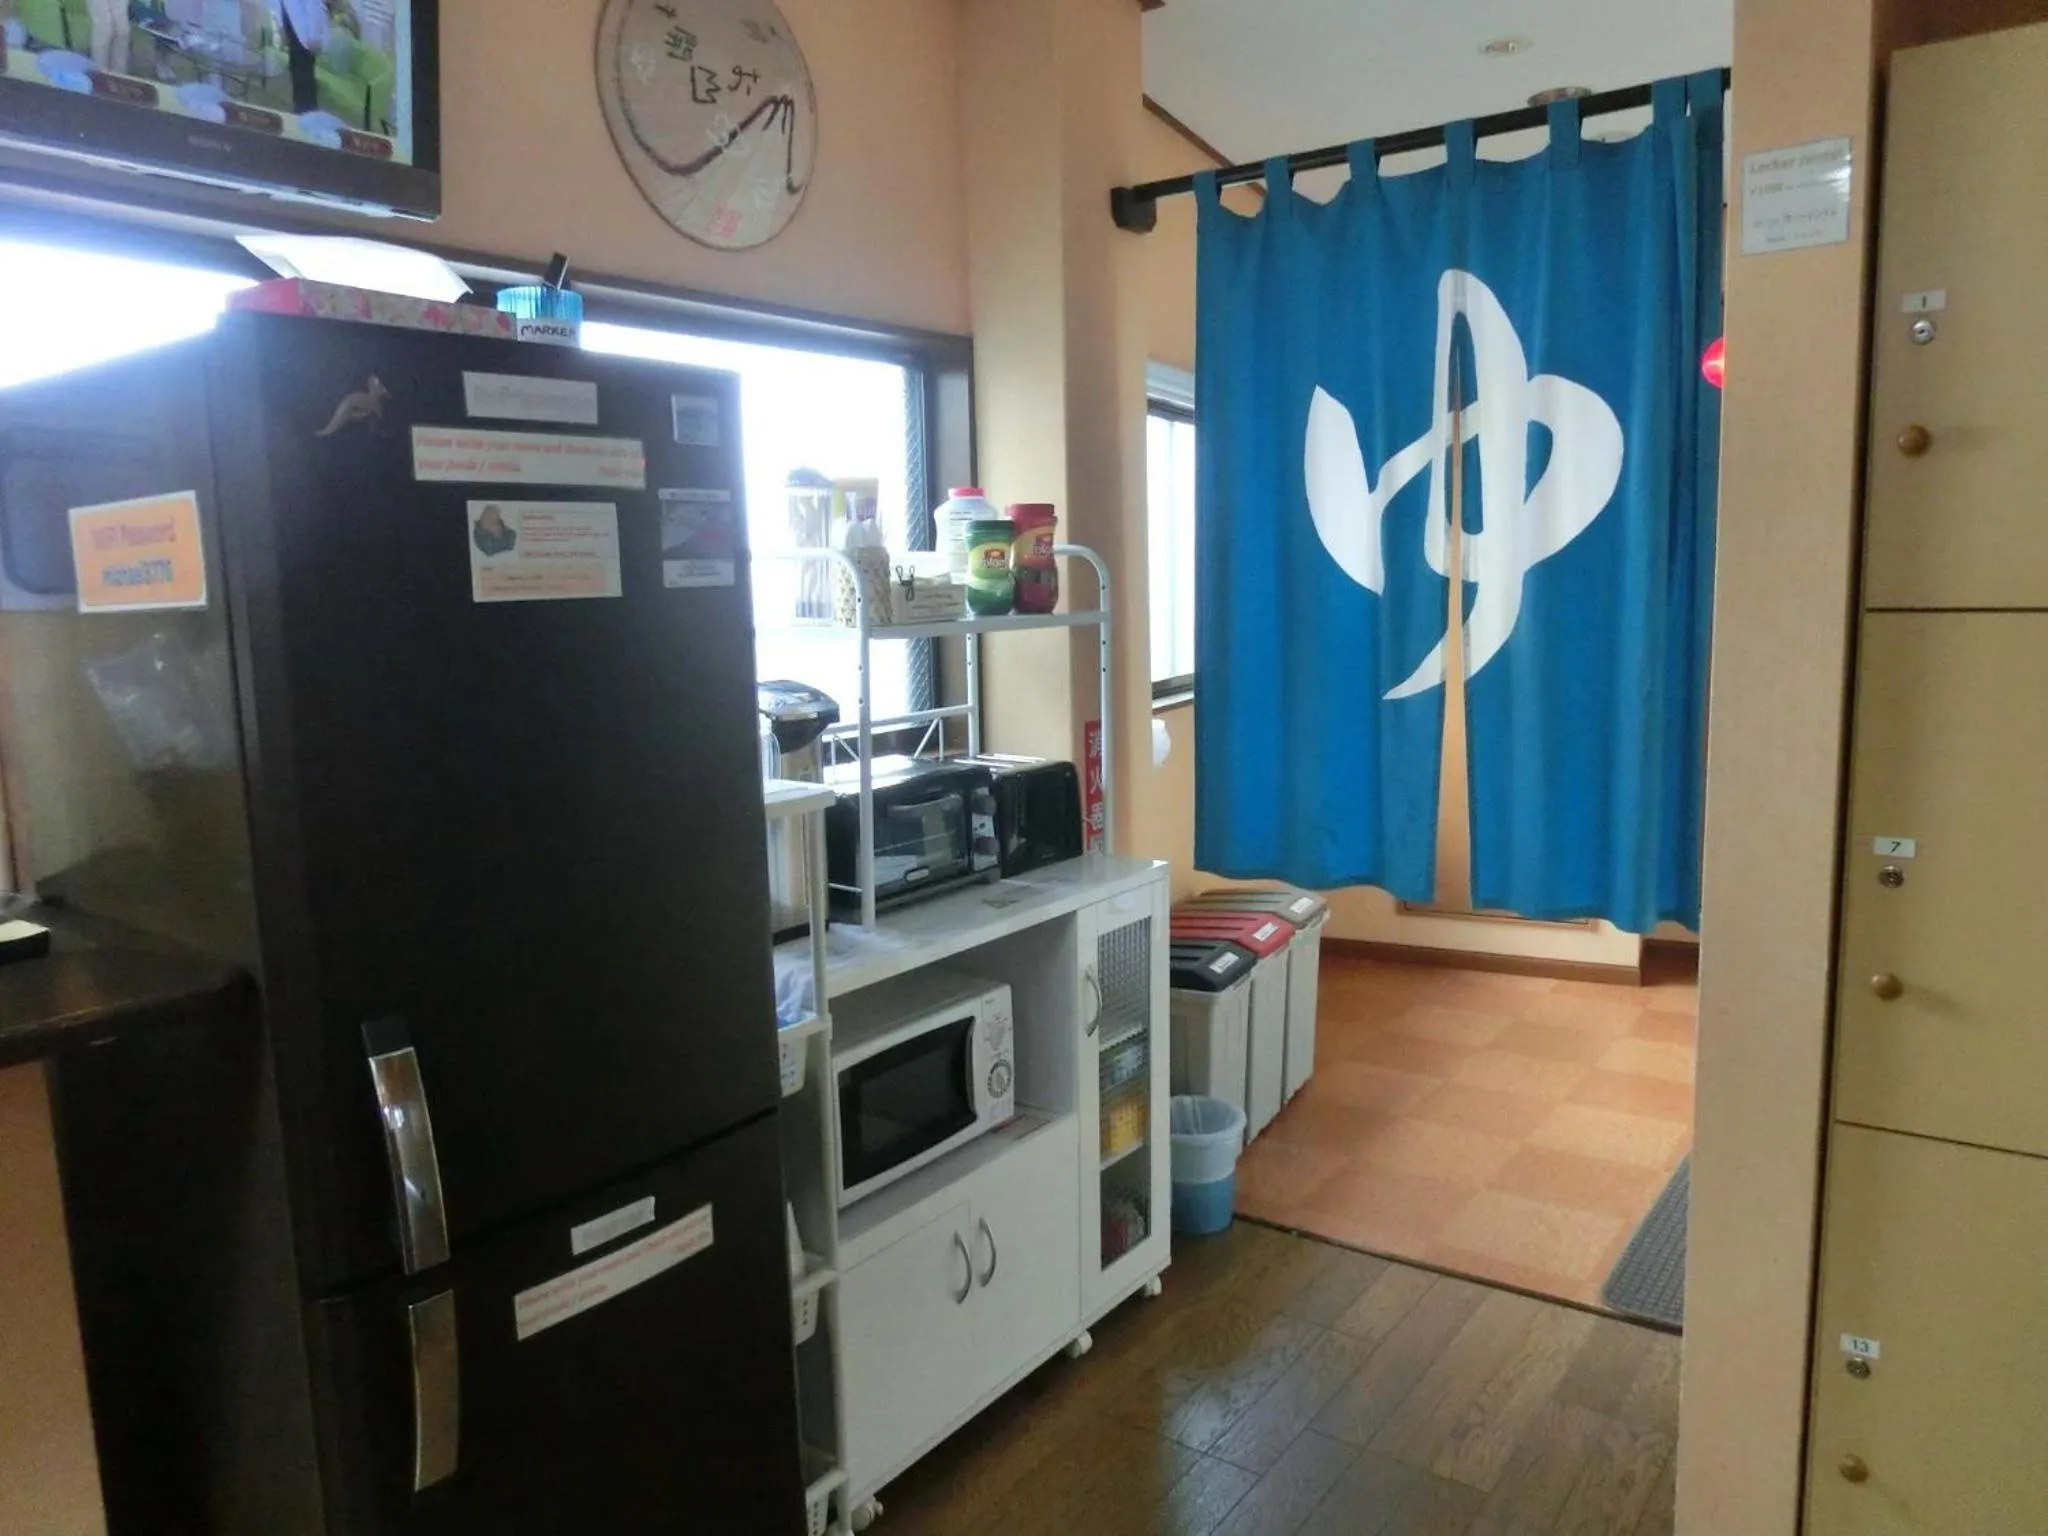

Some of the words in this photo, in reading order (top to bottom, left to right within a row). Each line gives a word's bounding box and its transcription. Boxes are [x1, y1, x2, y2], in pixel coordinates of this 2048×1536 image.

[1920, 294, 1928, 309] 1
[1304, 268, 1624, 699] ゆ
[1890, 841, 1901, 853] 7
[1852, 1339, 1870, 1353] 13
